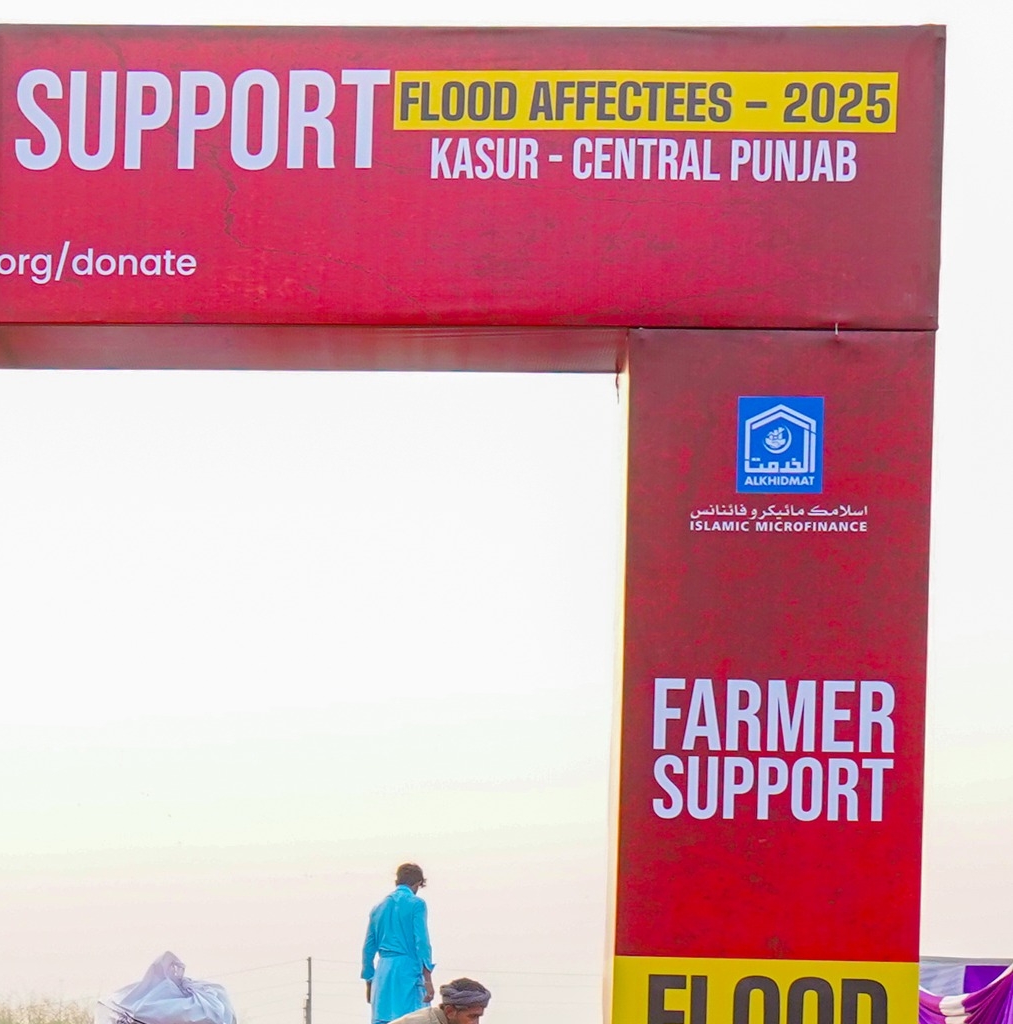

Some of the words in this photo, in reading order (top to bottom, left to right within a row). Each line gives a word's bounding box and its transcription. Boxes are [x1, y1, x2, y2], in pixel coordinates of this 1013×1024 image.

[15, 69, 390, 170] SUPPORT
[400, 81, 517, 121] FLOOD
[529, 81, 732, 122] AFFECTEES
[784, 83, 890, 123] 2025
[431, 138, 538, 179] KASUR
[573, 137, 720, 180] CENTRAL
[731, 140, 856, 181] PUNJAB
[745, 476, 814, 485] ALKHIDMAT
[690, 521, 749, 531] ISLAMIC
[756, 522, 867, 531] MICROFINANCE
[653, 678, 895, 753] FARMER
[653, 755, 894, 821] SUPPORT
